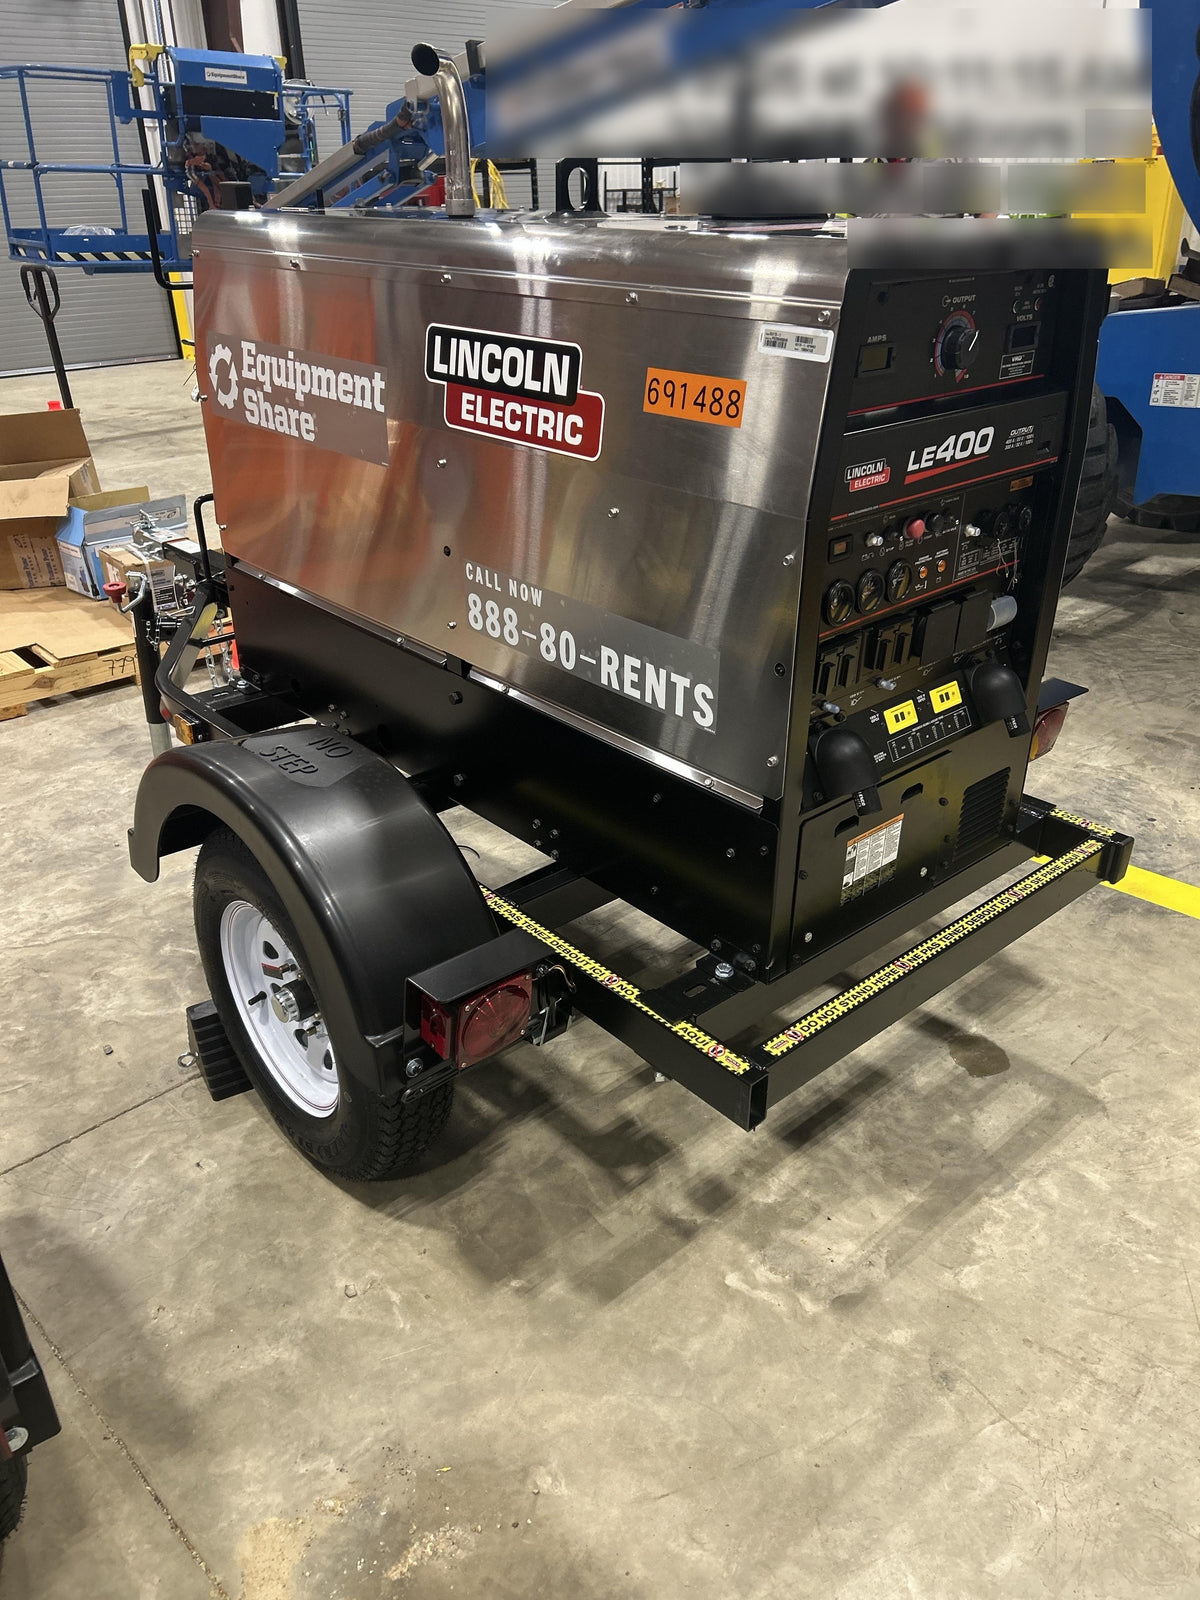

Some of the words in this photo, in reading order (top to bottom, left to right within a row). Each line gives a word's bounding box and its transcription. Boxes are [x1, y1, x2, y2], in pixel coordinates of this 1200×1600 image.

[952, 295, 976, 304] OUTPUT
[1016, 314, 1034, 322] VOLTS
[866, 334, 887, 343] AMPS
[241, 341, 386, 413] Equipment
[433, 335, 570, 396] LINCOLN
[243, 387, 316, 442] Share
[647, 377, 741, 419] 691488
[461, 392, 584, 446] ELECTRIC
[907, 426, 995, 472] LE400
[846, 461, 884, 480] LINCOLN
[854, 474, 886, 488] ELECTRIC
[465, 562, 502, 592] CALL
[509, 578, 543, 607] NOW
[259, 745, 319, 774] STEP
[307, 738, 353, 758] NO
[1018, 883, 1033, 894] NO
[1031, 877, 1043, 886] SE
[1043, 865, 1064, 880] PARE
[1062, 854, 1080, 867] AQUI
[491, 900, 505, 910] NE
[503, 906, 523, 921] PAS
[521, 920, 551, 940] TENEZ
[550, 940, 592, 966] DEBOUT
[589, 963, 605, 976] ICI
[908, 955, 921, 964] NE
[922, 942, 941, 955] PAS
[940, 925, 969, 943] TENEZ
[967, 904, 1001, 926] DEBOUT
[999, 896, 1011, 906] ICI
[617, 984, 635, 997] NO
[801, 1020, 818, 1033] DO
[817, 1006, 838, 1022] NOT
[839, 984, 873, 1008] STAND
[873, 968, 900, 987] HERE
[681, 1026, 710, 1047] AQUI
